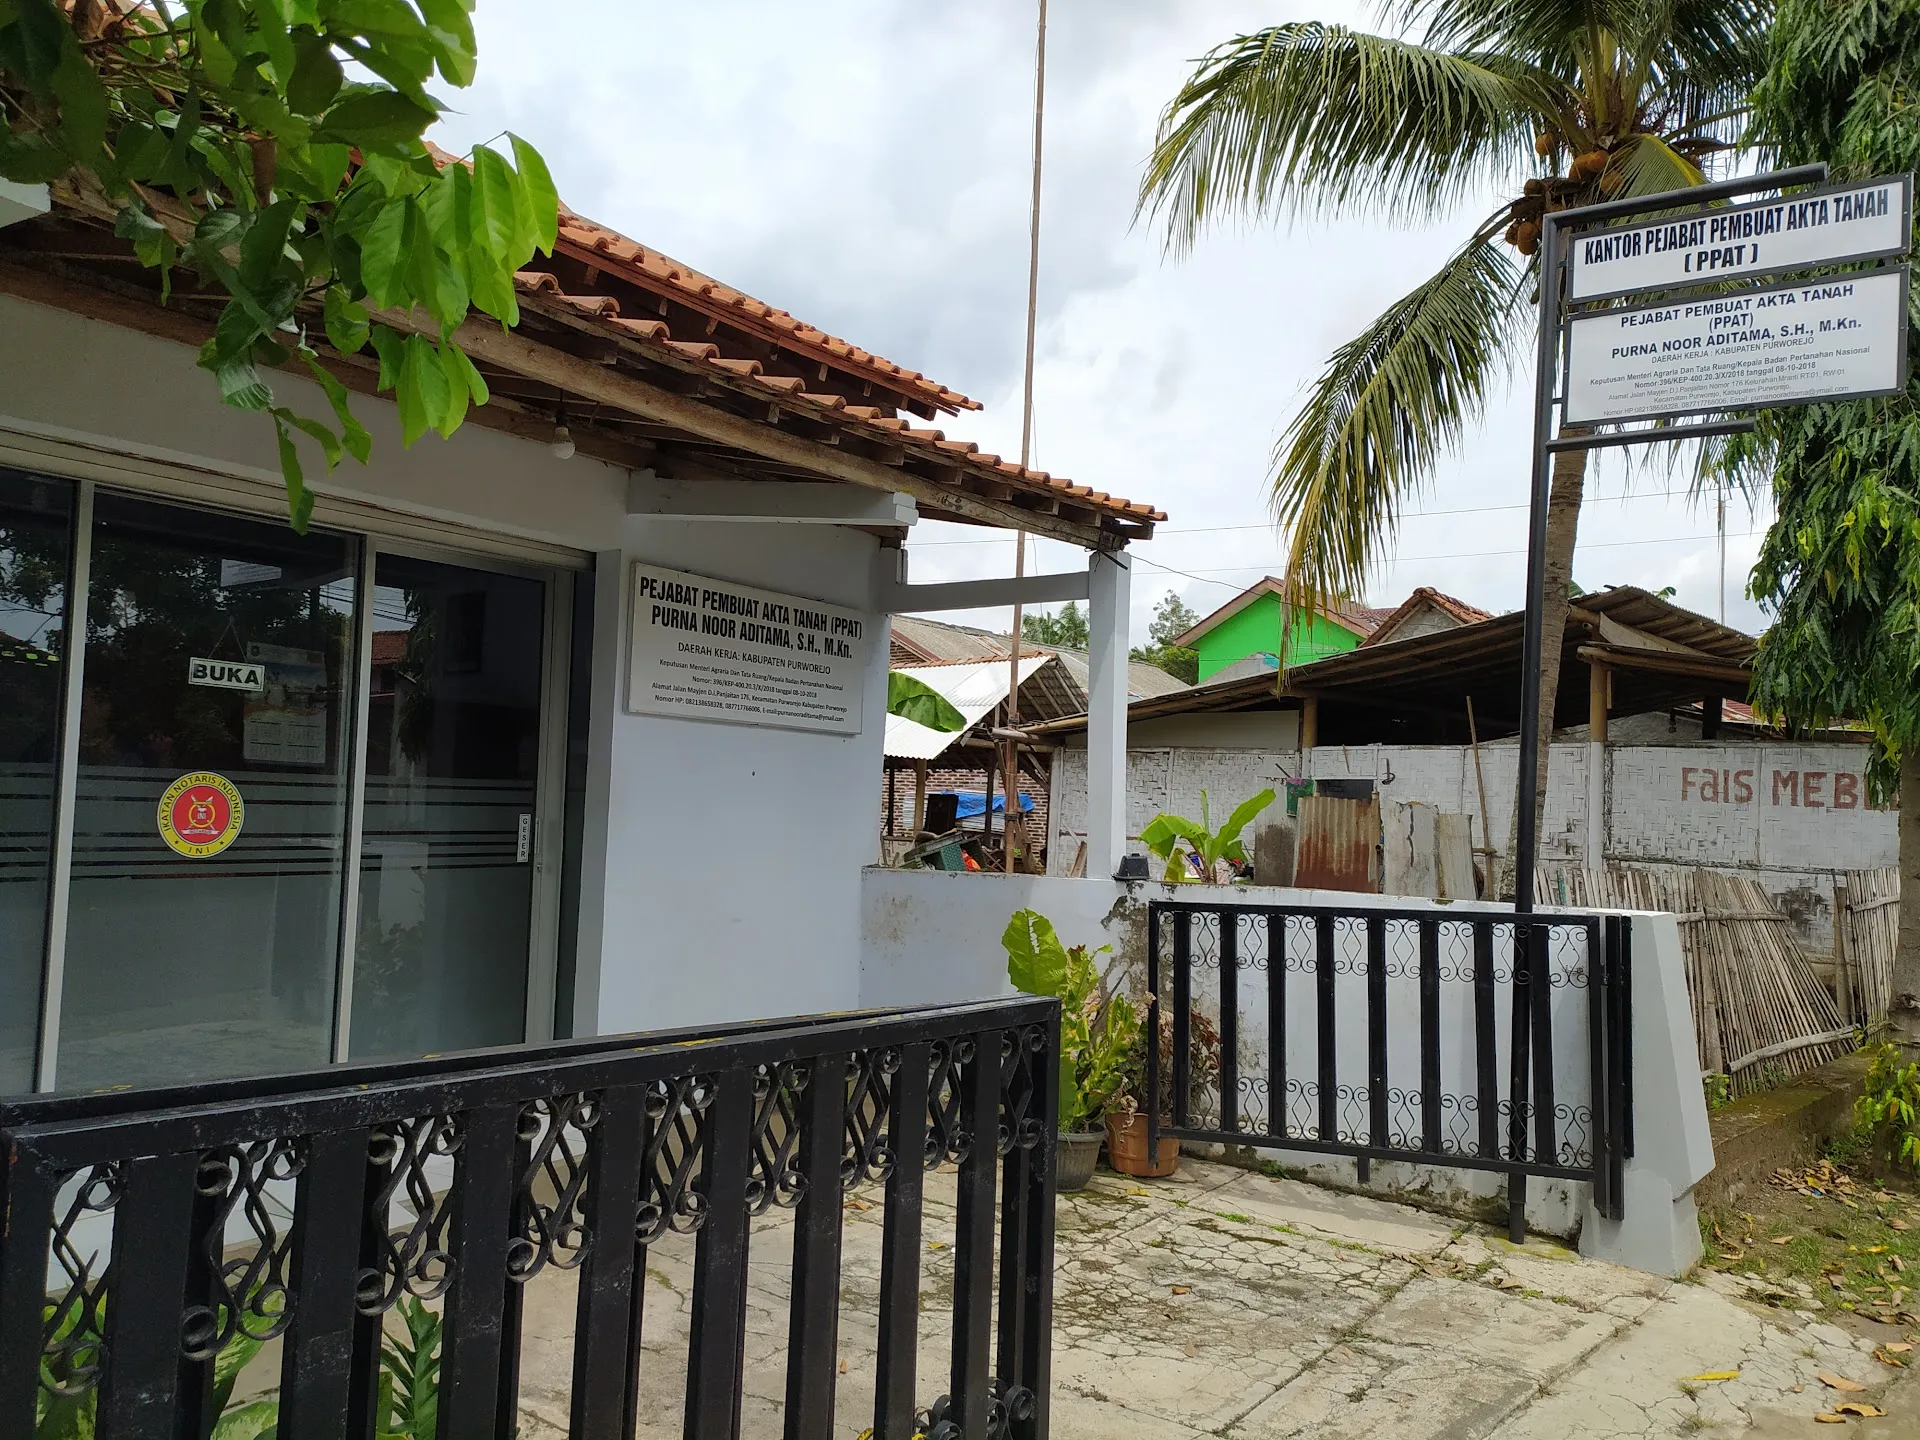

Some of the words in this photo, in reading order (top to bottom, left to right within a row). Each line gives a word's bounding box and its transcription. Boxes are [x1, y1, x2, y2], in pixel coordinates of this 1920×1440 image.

[1585, 232, 1642, 265] KANTOR
[1645, 220, 1707, 254] PEJABAT
[1710, 206, 1785, 244] PEMBUAT
[1786, 199, 1829, 230] AKTA
[1834, 188, 1889, 222] TANAH
[1621, 309, 1681, 328] PEJABAT
[1685, 299, 1753, 318] PEMBUAT
[1757, 292, 1796, 308] AKTA
[1802, 284, 1854, 302] TANAH
[1611, 343, 1658, 359] PURNA
[1662, 337, 1701, 352] NOOR
[1706, 328, 1775, 347] ADITAMA,
[1780, 323, 1814, 337] S.H.,
[1819, 317, 1862, 332] M.Kn.
[1709, 313, 1754, 333] (PPAT)
[1590, 374, 1625, 386] Keputusan
[1627, 371, 1652, 381] Menteri
[1653, 368, 1678, 379] Agraria
[1680, 367, 1694, 375] Dan
[1696, 365, 1711, 373] Tata
[1712, 359, 1762, 371] Ruang/Kepala
[1764, 356, 1788, 365] Badan
[1790, 351, 1834, 361] Pertanahan
[1836, 346, 1870, 356] Nasional
[1651, 353, 1682, 364] DAERAH
[1714, 343, 1761, 355] KABUPATEN
[1763, 337, 1814, 349] PURWOREJO
[1746, 367, 1774, 378] tanggal
[1775, 362, 1816, 372] 08-10-2018
[640, 576, 699, 607] PEJABAT
[702, 589, 760, 618] PEMBUAT
[762, 602, 790, 625] AKTA
[793, 608, 828, 632] TANAH
[831, 616, 862, 640] (PPAT)
[651, 605, 698, 632] PURNA
[702, 614, 736, 639] NOOR
[739, 622, 794, 651] ADITAMA,
[797, 632, 821, 656] S.H.,
[824, 637, 852, 659] M.Kn.
[193, 663, 260, 685] BUKA
[678, 642, 712, 656] DAERAH
[714, 648, 740, 661] KERJA:
[742, 652, 785, 668] KABUPATEN
[787, 660, 831, 674] PURWOREJO
[659, 659, 688, 669] Keputusan
[689, 663, 711, 672] Menteri
[711, 667, 729, 676] Agraria
[730, 669, 740, 677] Dan
[752, 672, 784, 683] Ruang/Kepala
[785, 677, 799, 685] Badan
[800, 680, 825, 689] Pertanahan
[825, 683, 844, 691] Nasional
[692, 676, 712, 685] Nomor:
[775, 687, 792, 696] tanggal
[651, 682, 672, 690] Alamat
[672, 685, 686, 693] Jalan
[751, 695, 778, 704] Kecamatan
[802, 701, 826, 711] Kabupaten
[654, 694, 674, 702] Nomor
[161, 793, 175, 831] IKATAN
[174, 775, 217, 791] NOTARIS
[217, 780, 241, 830] INDONESIA
